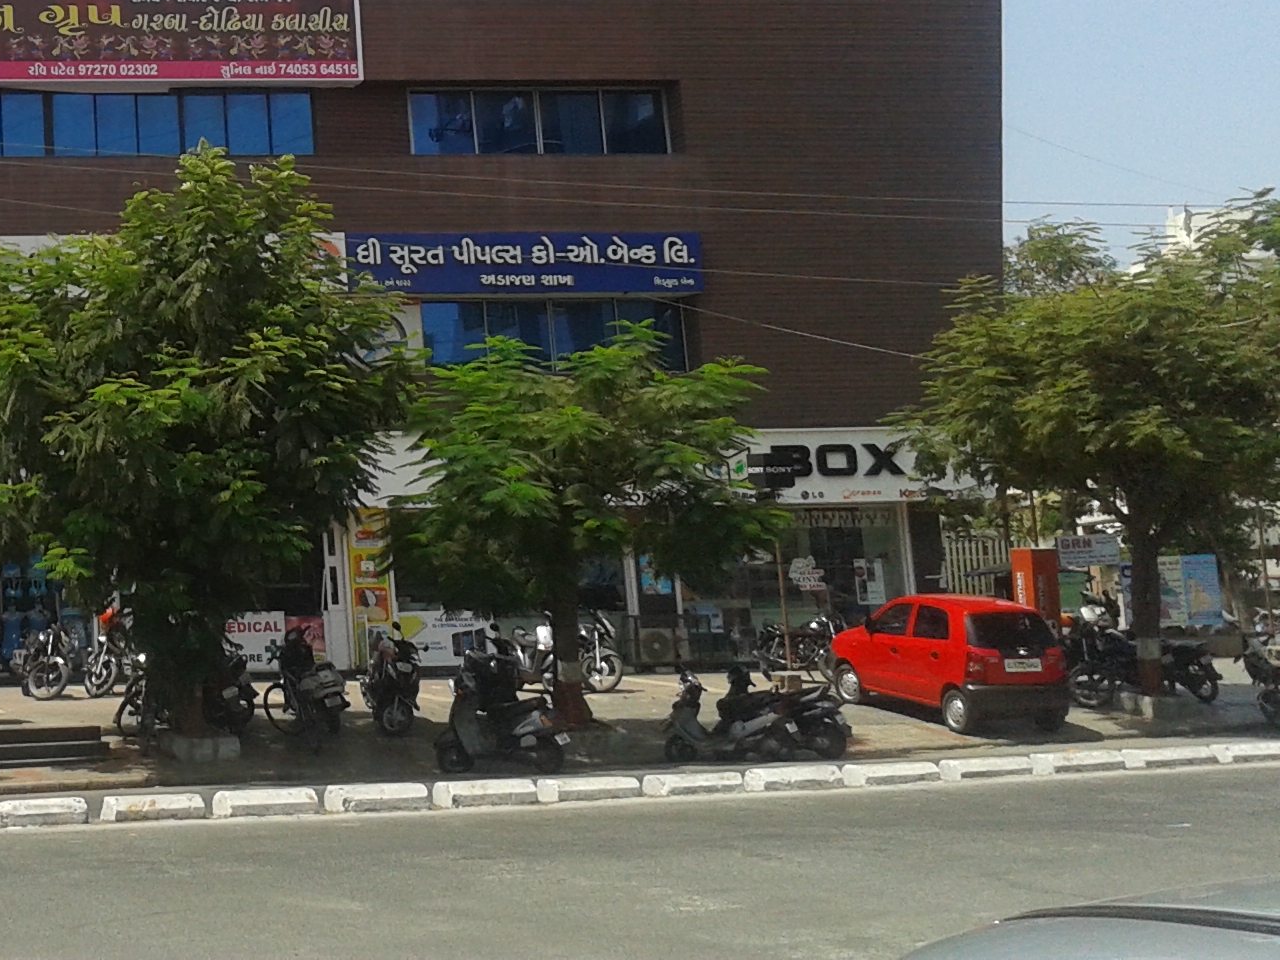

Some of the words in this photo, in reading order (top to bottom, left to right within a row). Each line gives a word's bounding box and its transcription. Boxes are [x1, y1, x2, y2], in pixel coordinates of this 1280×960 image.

[28, 63, 46, 76] રવિ
[50, 63, 75, 76] પટેલ
[78, 64, 116, 76] 97270
[120, 64, 158, 76] 02302
[280, 64, 317, 76] 74053
[356, 237, 381, 265] ધી
[389, 243, 444, 275] સૂરત
[452, 237, 522, 265] પીપલ્સ
[480, 273, 535, 286] અડાજણ
[541, 274, 574, 287] શાખા
[766, 466, 794, 474] SONY
